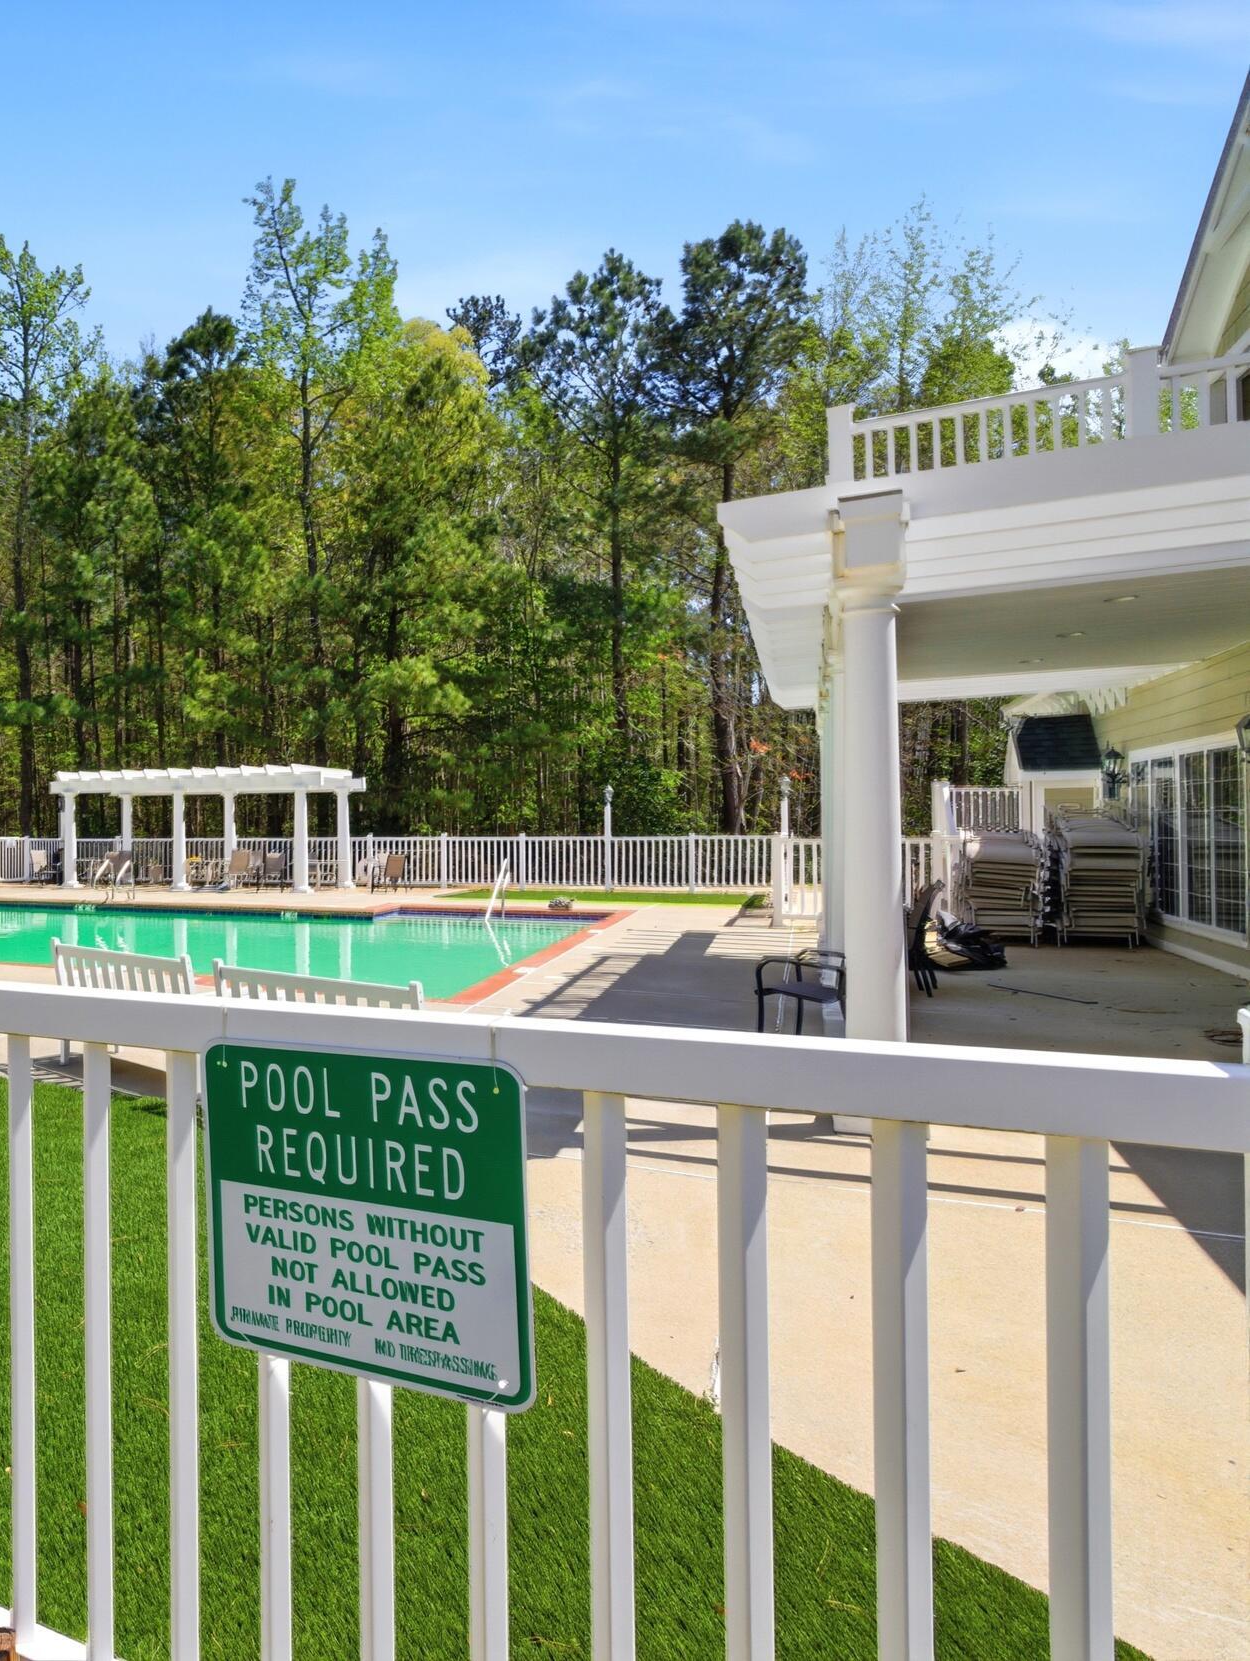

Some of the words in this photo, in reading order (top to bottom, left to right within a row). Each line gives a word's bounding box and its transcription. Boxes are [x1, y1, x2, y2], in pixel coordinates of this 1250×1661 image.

[240, 1060, 341, 1119] POOL
[370, 1071, 479, 1134] PASS
[256, 1124, 466, 1201] REQUIRED
[243, 1193, 355, 1232] PERSONS
[366, 1213, 484, 1254] WITHOUT
[245, 1222, 317, 1255] VALID
[330, 1237, 400, 1271] POOL
[413, 1251, 486, 1286] PASS
[268, 1284, 291, 1308] IN
[305, 1291, 373, 1327] POOL
[386, 1310, 461, 1345] AREA
[271, 1256, 319, 1285] NOT
[331, 1268, 456, 1313] ALLOWED
